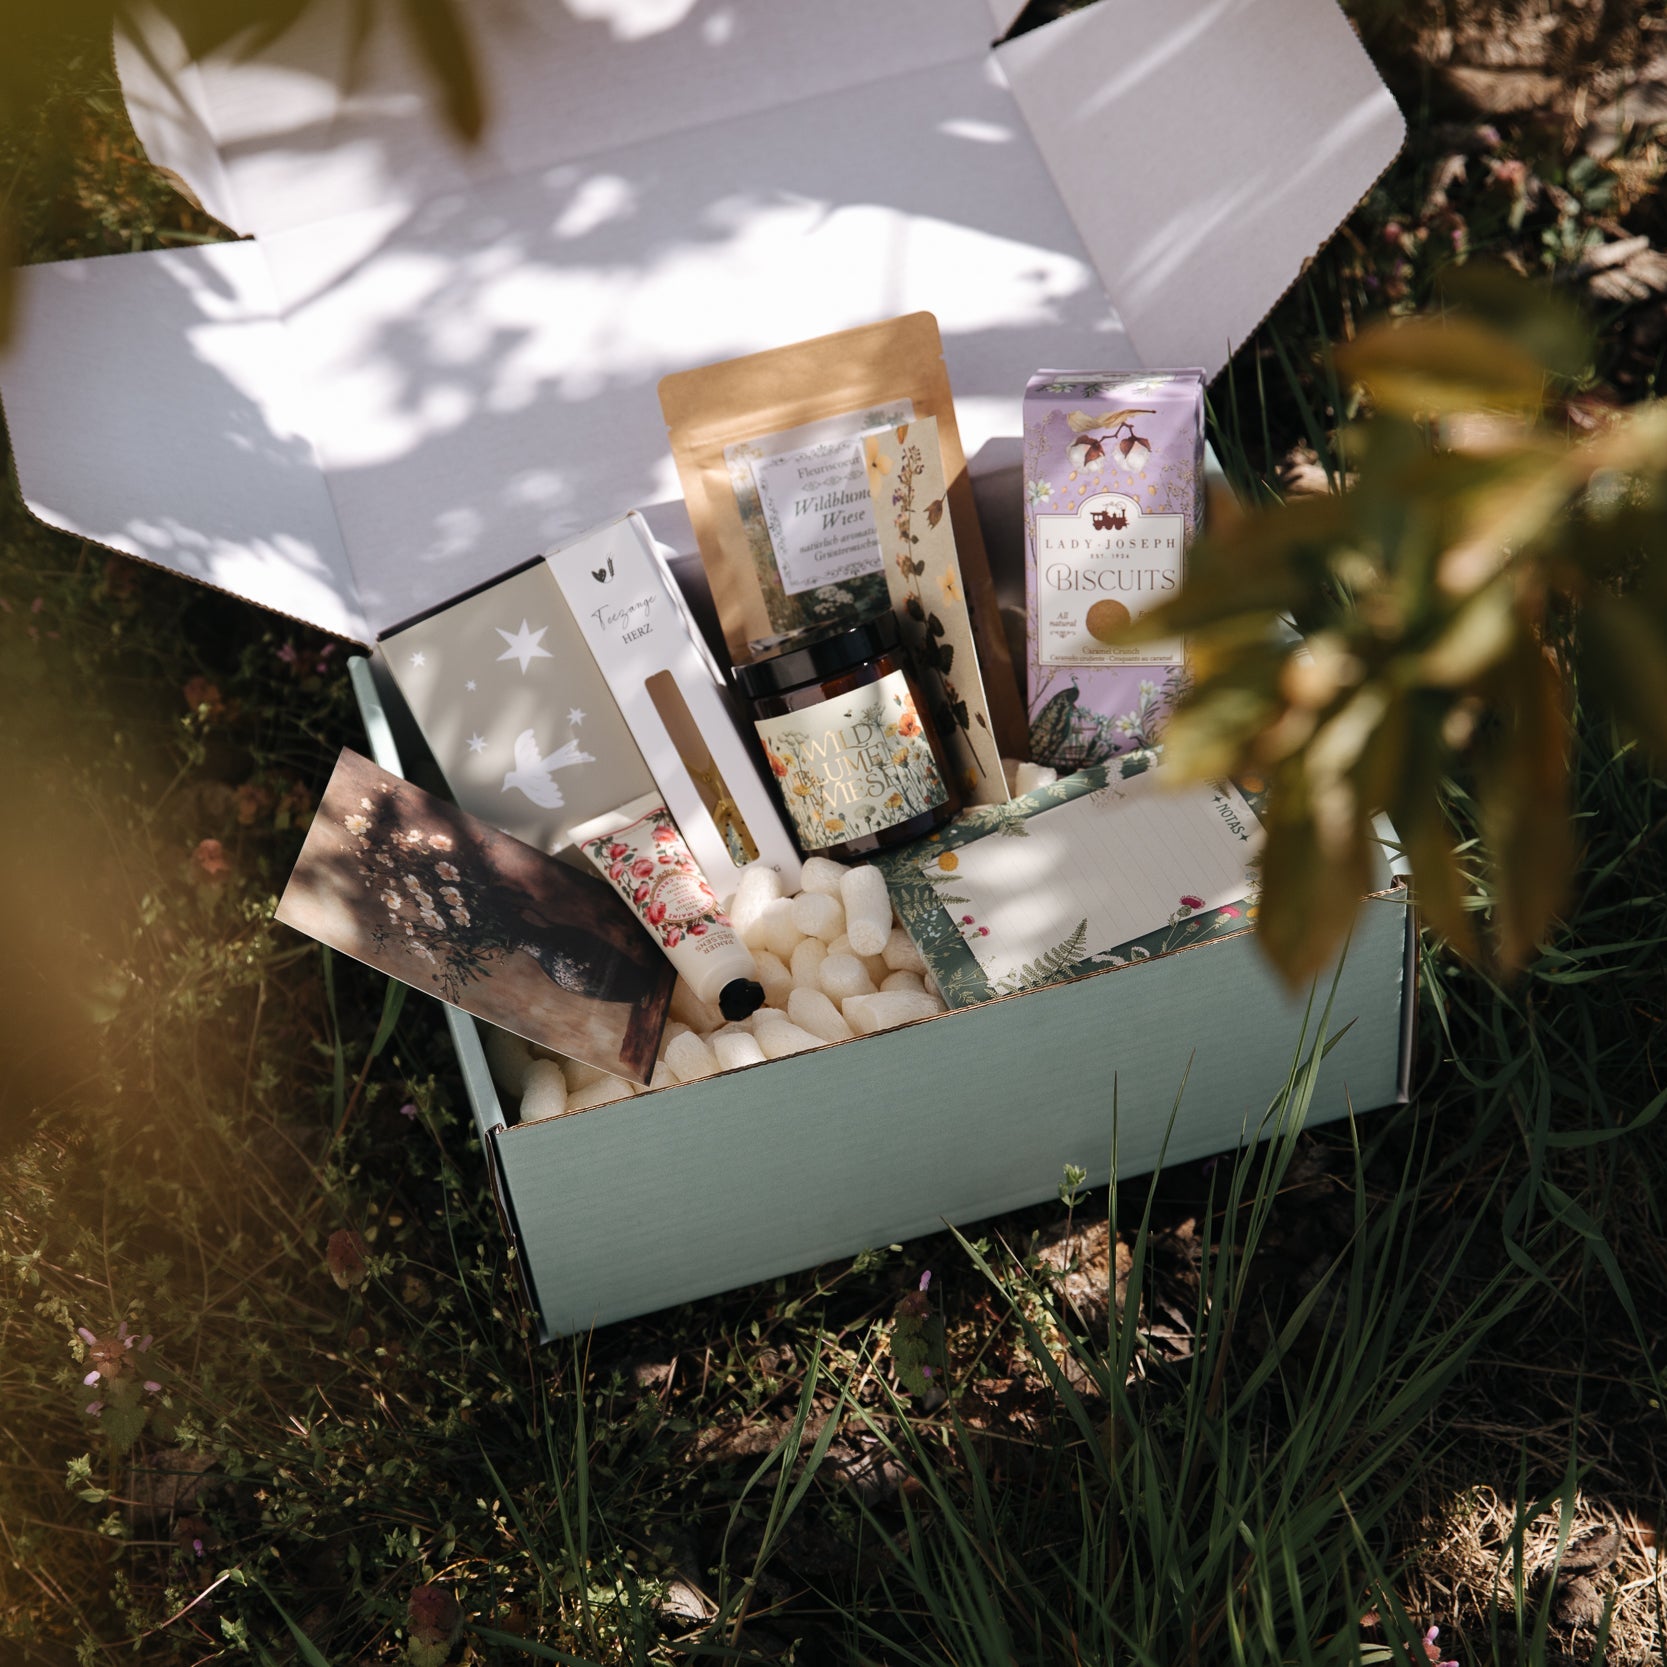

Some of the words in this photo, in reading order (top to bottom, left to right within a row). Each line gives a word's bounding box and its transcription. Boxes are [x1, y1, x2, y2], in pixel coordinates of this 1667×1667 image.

[822, 509, 866, 531] Wiese
[1045, 538, 1093, 550] LADY
[1105, 538, 1176, 550] JOSEPH
[1045, 562, 1176, 592] BISCUITS
[590, 594, 657, 631] Teezange
[1049, 619, 1077, 627] natural
[621, 623, 654, 645] HERZ
[799, 722, 873, 762] WILD
[1215, 803, 1245, 835] NOTAS
[702, 939, 734, 954] PANIER
